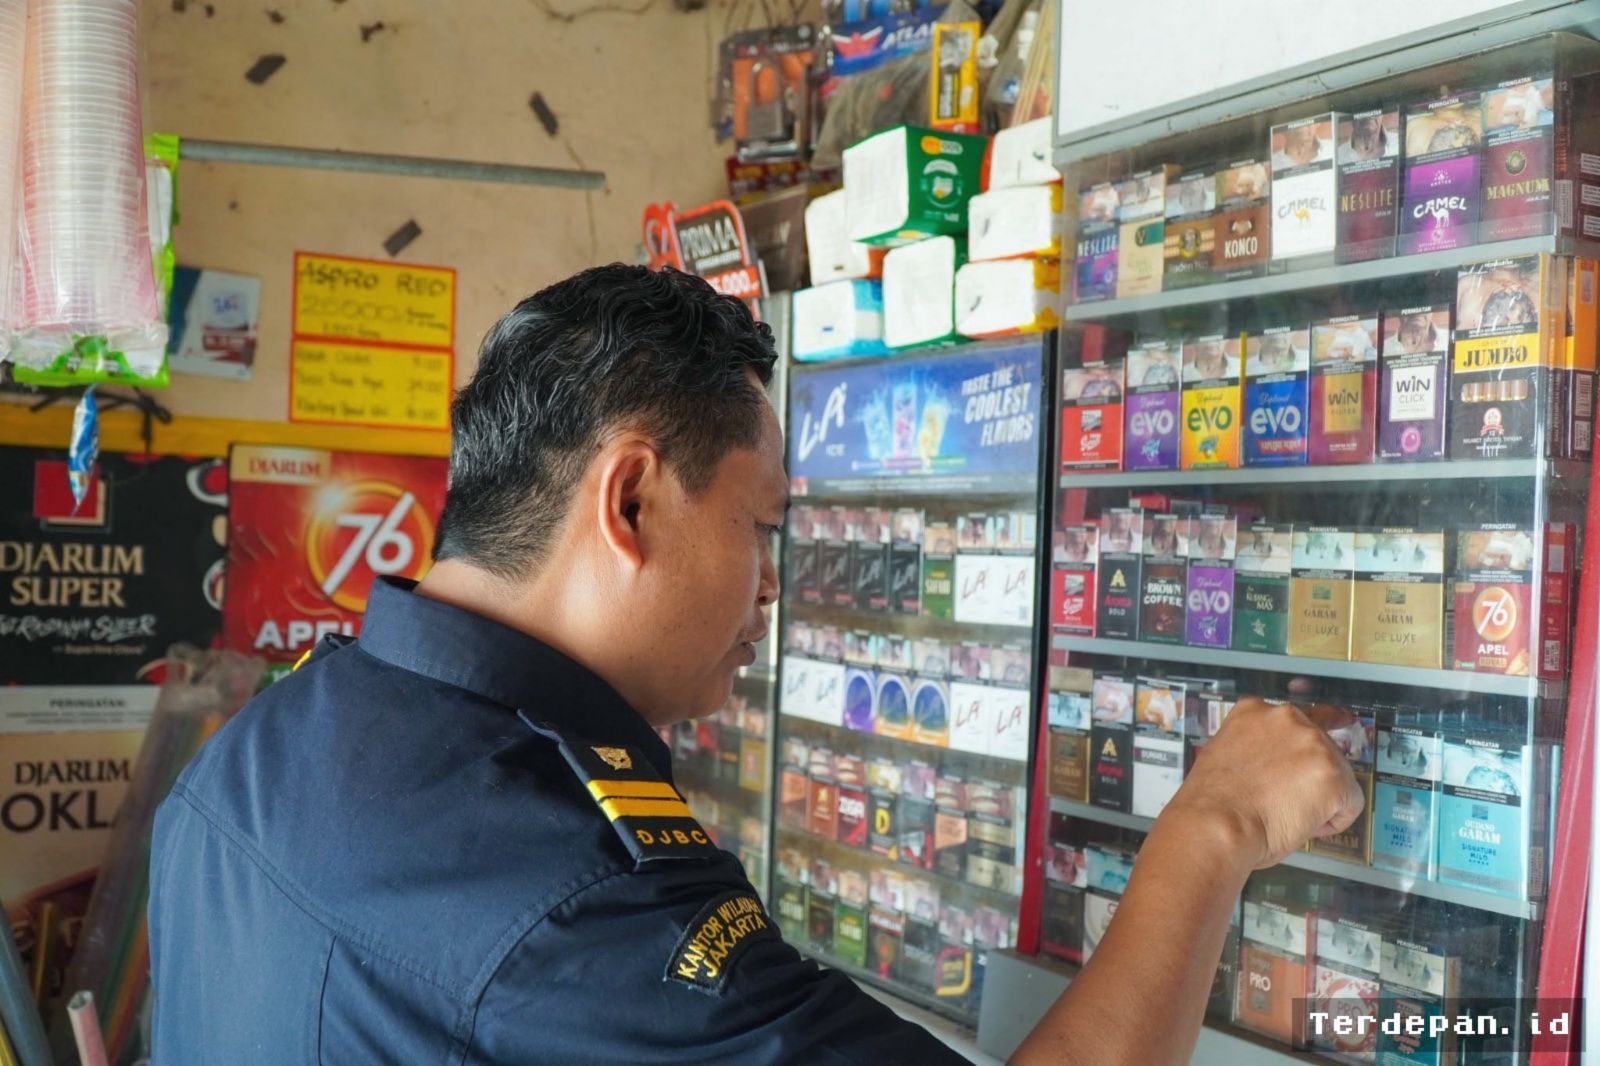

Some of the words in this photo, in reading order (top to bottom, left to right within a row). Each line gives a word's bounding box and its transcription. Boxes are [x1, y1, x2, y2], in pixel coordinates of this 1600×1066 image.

[1341, 189, 1393, 212] NESLITE
[1487, 178, 1550, 201] MAGNUM
[1278, 197, 1327, 219] CAMEL
[1413, 196, 1467, 218] CAMEL
[679, 216, 740, 262] PRIMA
[1077, 234, 1117, 257] NESLITE
[1224, 236, 1257, 258] KONCO
[397, 272, 447, 297] RED
[1463, 345, 1528, 368] JUMBO
[964, 382, 1032, 425] COOLEST
[1130, 408, 1175, 436] evo
[1187, 405, 1232, 433] evo
[1250, 405, 1301, 434] evo
[249, 458, 322, 476] DJARUM
[322, 492, 416, 596] 76
[0, 542, 144, 576] DJARUM
[10, 576, 126, 608] SUPER
[1147, 582, 1182, 596] BROWN
[1143, 595, 1184, 608] COFFEE
[1188, 589, 1230, 614] evo
[1478, 591, 1508, 635] 76
[1315, 624, 1339, 636] LUXE
[1378, 613, 1413, 625] GARAM
[1390, 632, 1416, 644] LUXE
[1477, 643, 1510, 656] APEL
[15, 759, 130, 786] DJARUM
[1459, 827, 1501, 845] GARAM
[1461, 843, 1497, 856] SIGNATURE
[1470, 851, 1489, 861] MILD
[677, 916, 723, 979] KANTOR
[703, 913, 767, 978] JAKARTA
[1249, 972, 1271, 992] PRO
